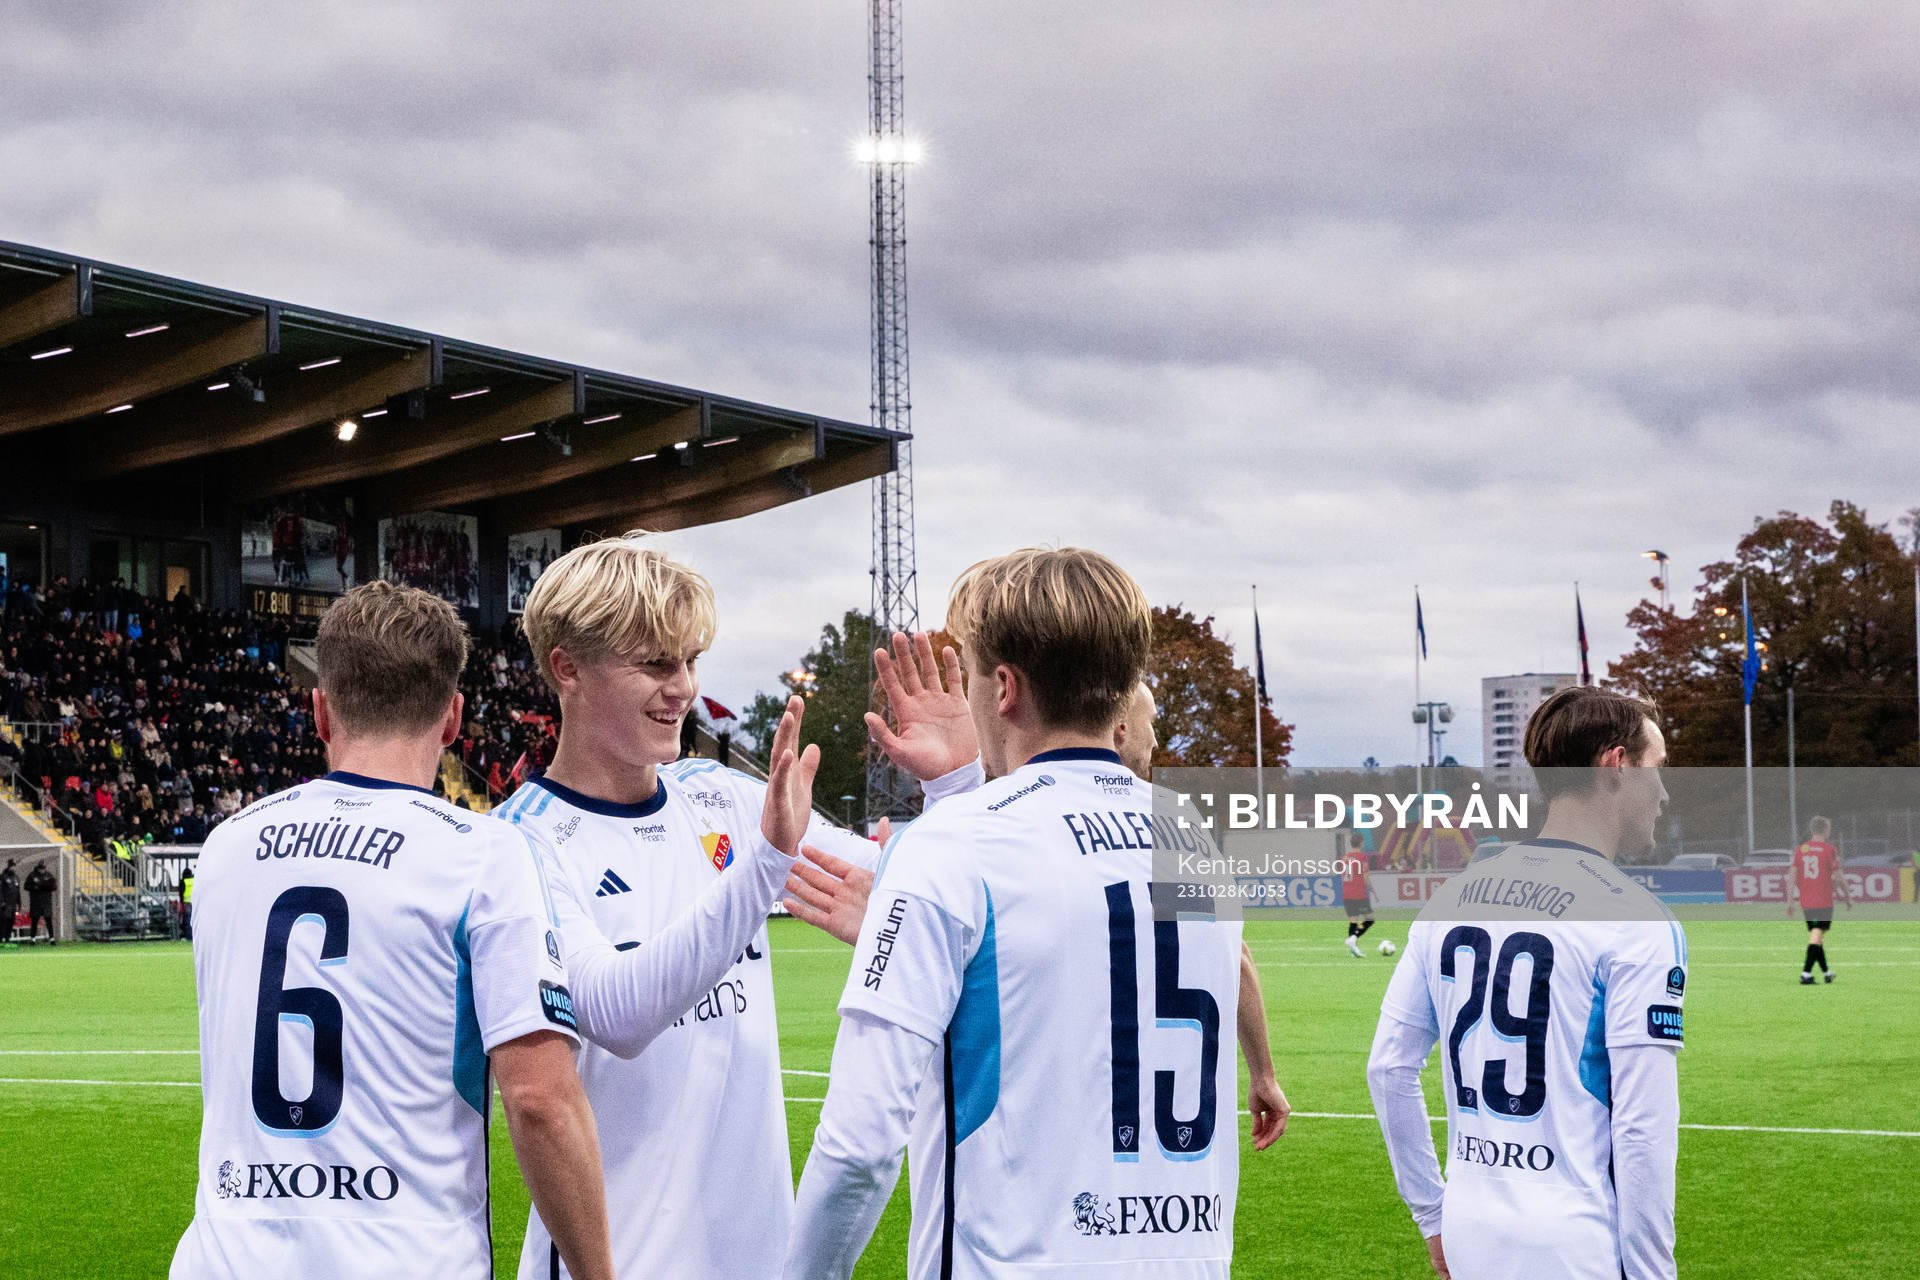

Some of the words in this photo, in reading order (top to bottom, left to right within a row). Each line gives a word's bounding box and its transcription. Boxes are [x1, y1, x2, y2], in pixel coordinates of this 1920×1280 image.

[986, 780, 1042, 811] Sundström
[1094, 775, 1133, 786] Prioritet
[1102, 785, 1131, 796] Finans
[408, 799, 458, 827] Sundström
[255, 816, 406, 870] SCHÜLLER
[1061, 811, 1212, 859] FALLENIUS
[1731, 873, 1894, 899] BEGO
[1802, 855, 1820, 880] 13
[1457, 877, 1576, 919] MILLESKOG
[863, 897, 908, 992] stadium
[251, 885, 350, 1139] 6
[543, 988, 575, 1016] UNIB
[1651, 1011, 1684, 1027] UNIB
[1103, 879, 1221, 1163] 15
[1440, 925, 1555, 1123] 29
[1464, 1135, 1555, 1171] FXORO
[242, 1163, 400, 1201] FXORO
[1117, 1193, 1222, 1235] FXORO
